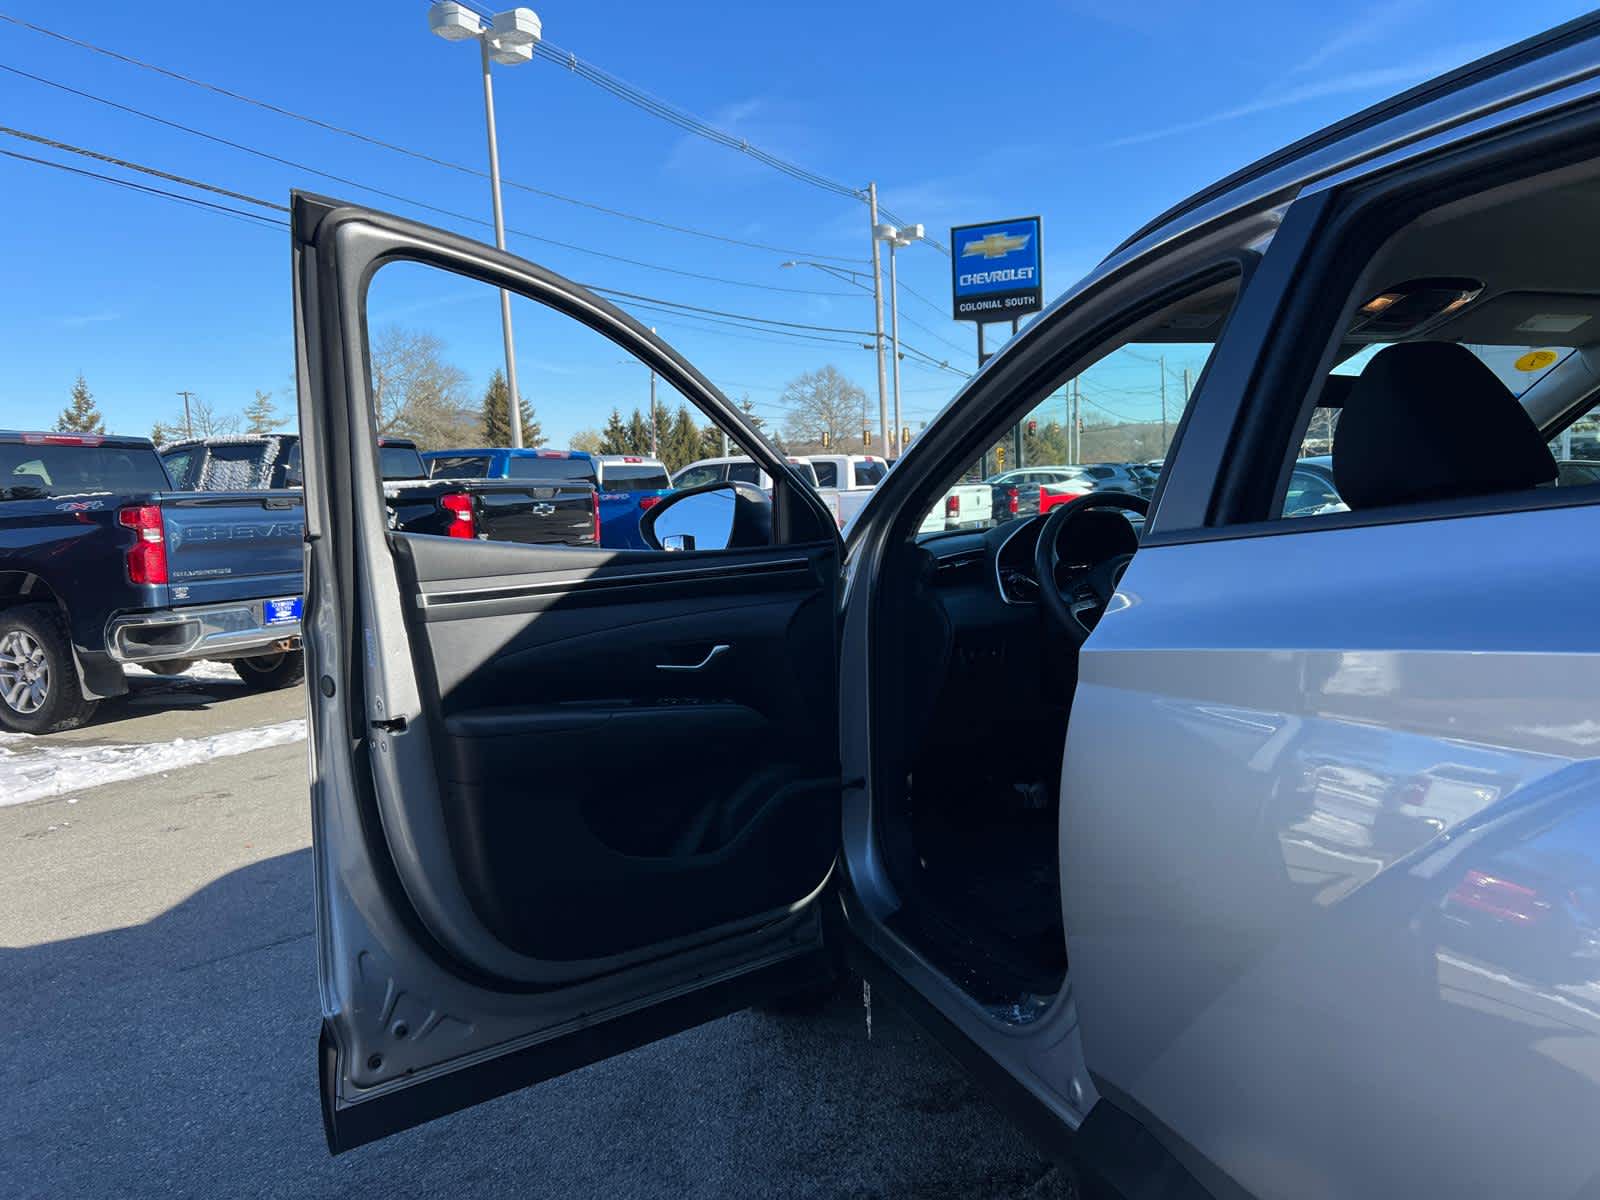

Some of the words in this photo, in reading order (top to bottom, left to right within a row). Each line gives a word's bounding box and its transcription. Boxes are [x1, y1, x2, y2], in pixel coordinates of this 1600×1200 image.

[959, 267, 1034, 286] CHEVROLET
[959, 300, 1003, 312] COLONIAL
[1005, 296, 1035, 306] SOUTH
[182, 523, 304, 540] CHEVR
